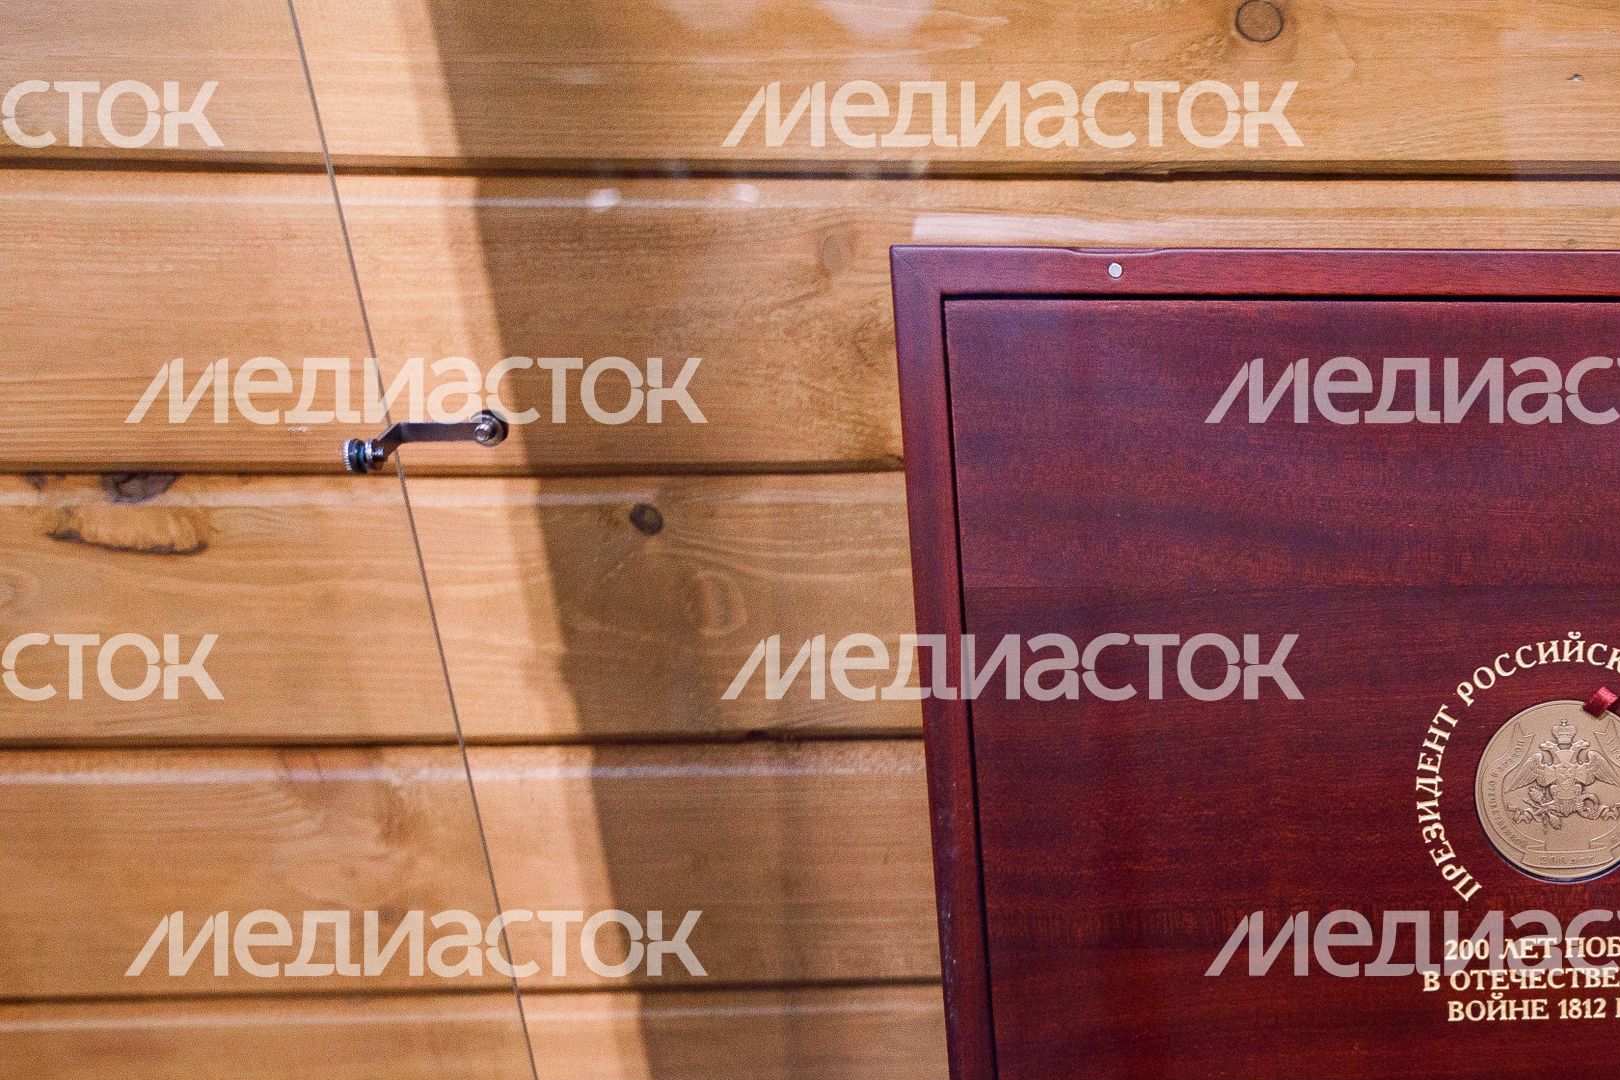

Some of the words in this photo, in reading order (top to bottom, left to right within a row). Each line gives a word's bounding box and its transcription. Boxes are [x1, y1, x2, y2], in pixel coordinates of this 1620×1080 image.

[1416, 704, 1482, 901] ПРЕЗИДЕНТ
[1444, 939, 1490, 960] 200
[1499, 937, 1561, 960] ЛЕТ
[1423, 971, 1440, 991] В
[1447, 992, 1549, 1021] ВОЙНЕ
[1558, 998, 1606, 1019] 1812
